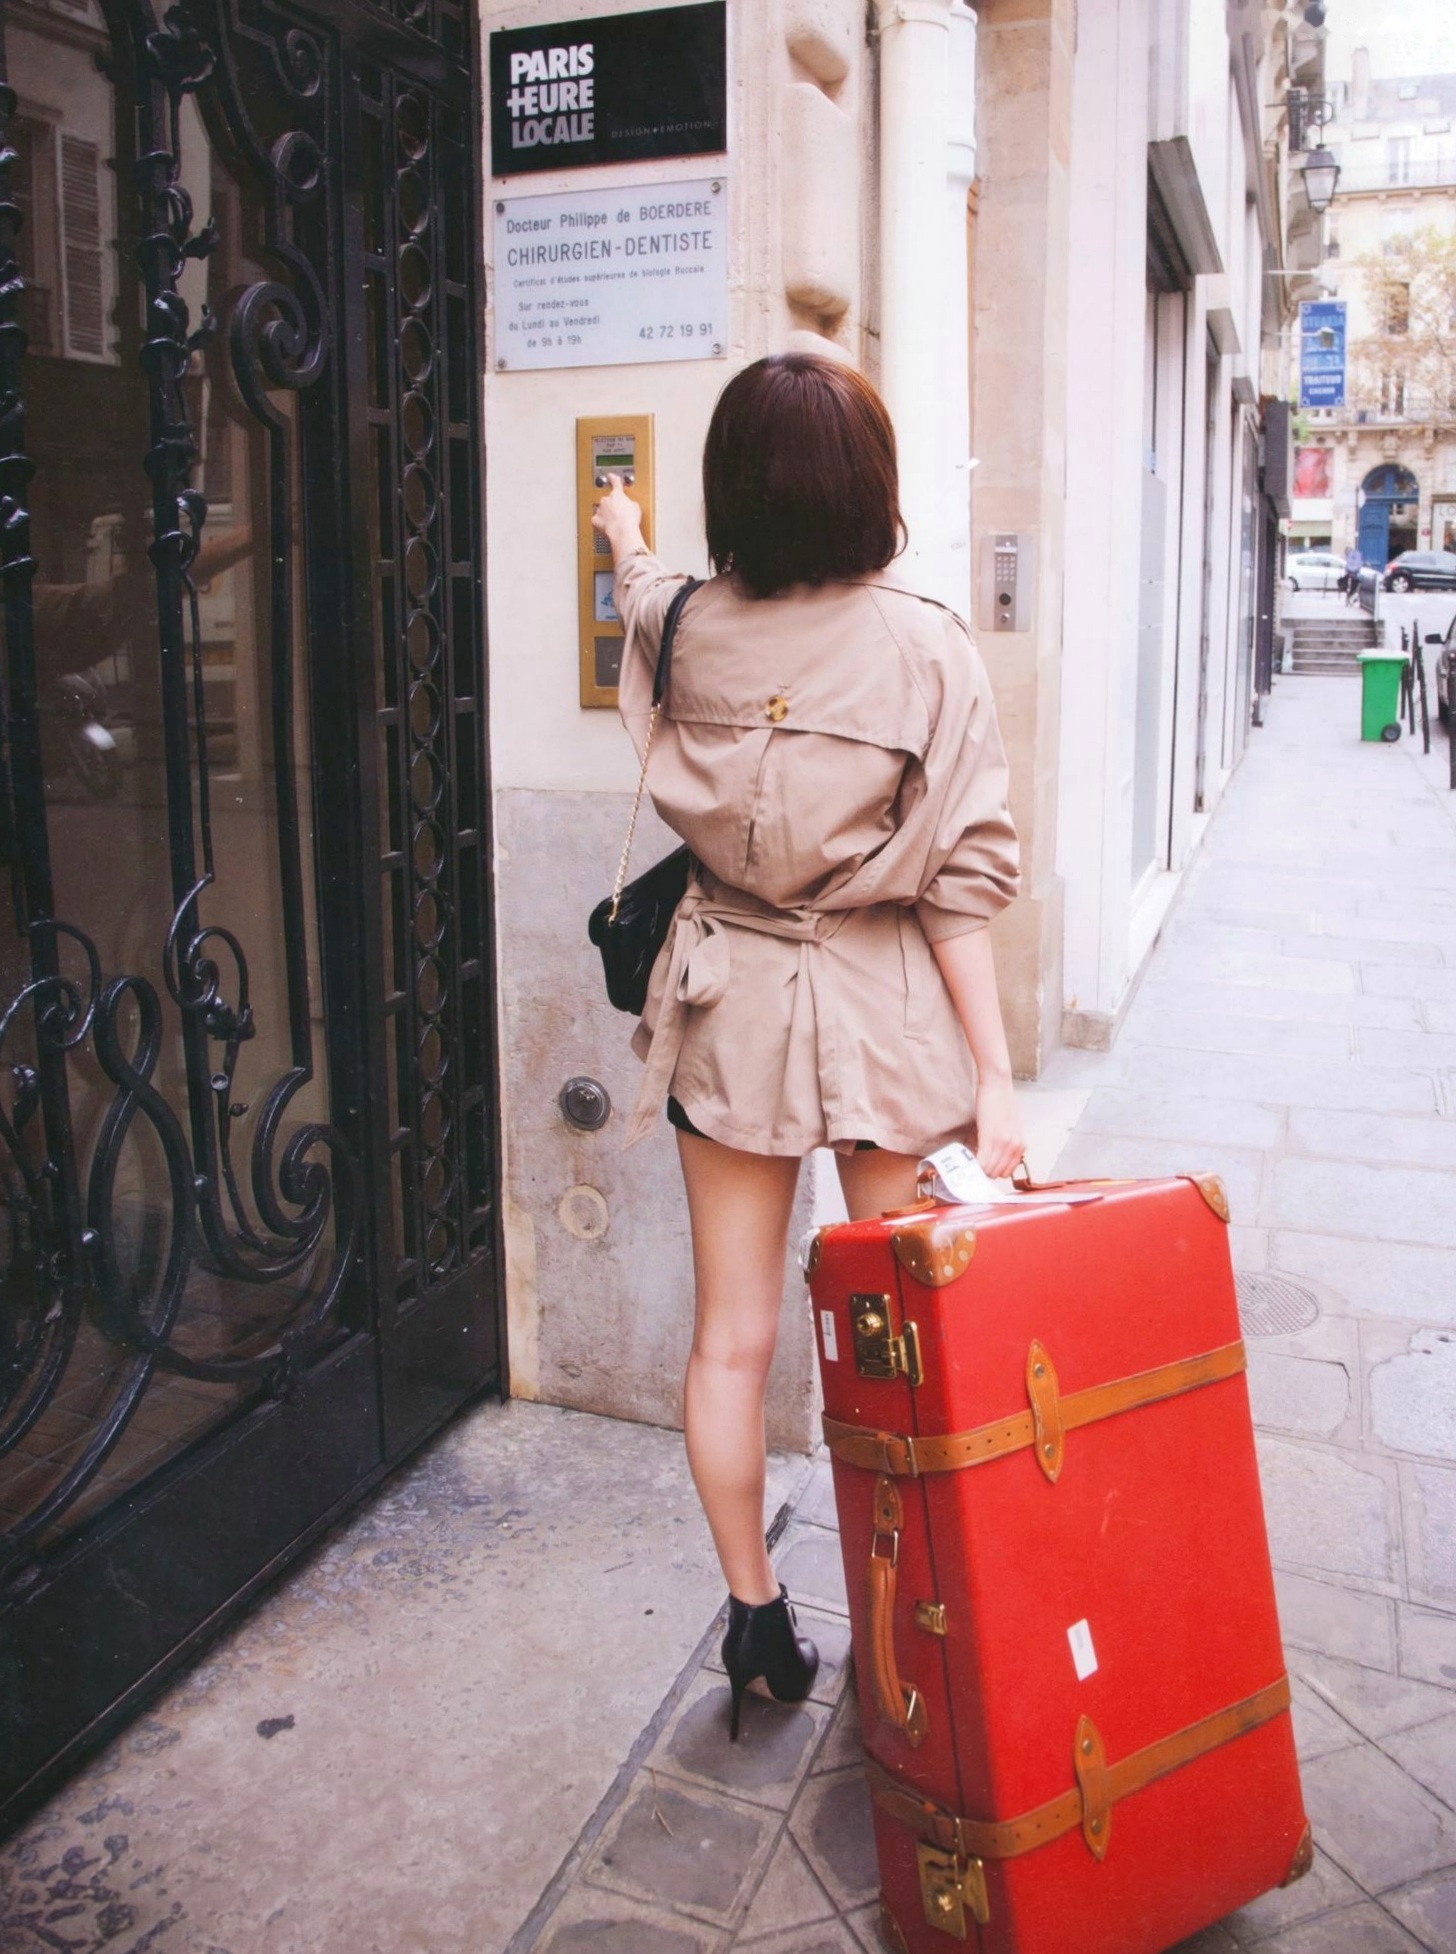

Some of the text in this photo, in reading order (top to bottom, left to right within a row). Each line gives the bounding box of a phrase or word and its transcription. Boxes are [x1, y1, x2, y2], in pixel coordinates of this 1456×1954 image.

[511, 43, 594, 85] PARIS
[512, 112, 595, 149] LOCALE
[506, 201, 712, 234] Docteur Philippe de BOERDERE
[518, 298, 589, 312] Sur rendez-vous
[508, 315, 600, 331] du Lundi au Vendredi
[639, 322, 713, 340] 42 72 19 91
[527, 338, 537, 348] de
[541, 336, 553, 347] 9h
[567, 334, 582, 345] 19h
